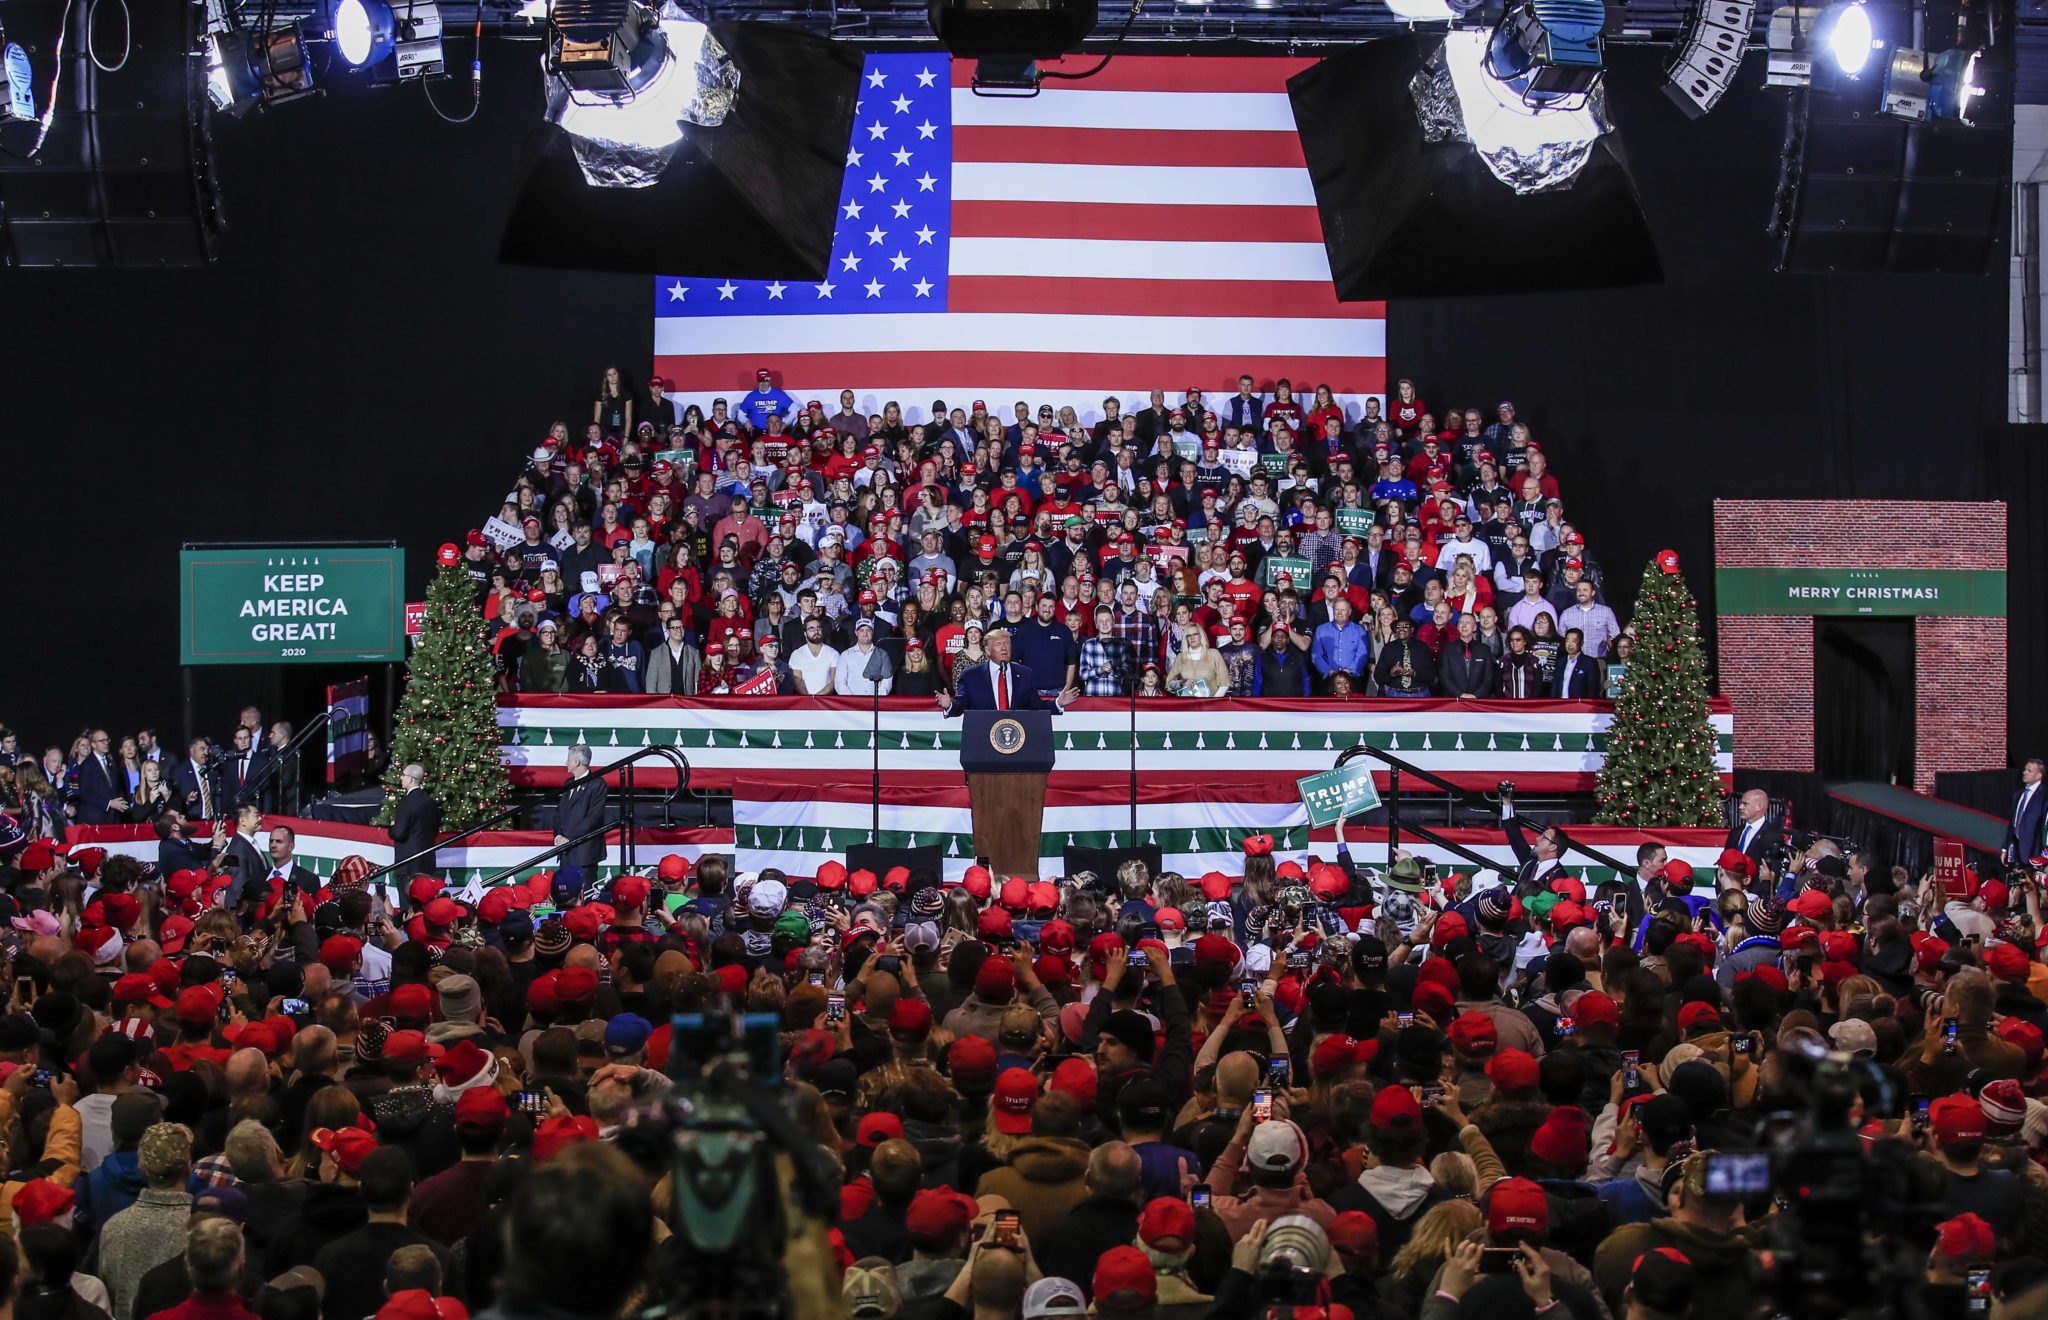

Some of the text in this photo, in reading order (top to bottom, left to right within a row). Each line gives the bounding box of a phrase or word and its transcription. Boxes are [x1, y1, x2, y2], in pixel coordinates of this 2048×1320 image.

[400, 53, 415, 61] ARRI
[1791, 63, 1805, 71] ARRI
[1336, 515, 1373, 524] TRUMP
[489, 525, 523, 541] TRUMP
[264, 574, 324, 592] KEEP
[1789, 587, 1938, 599] MERRY CHRISTMAS!
[239, 598, 348, 617] AMERICA
[251, 622, 336, 641] GREAT!
[281, 648, 306, 657] 2020
[1306, 776, 1367, 801] TRUMP
[1315, 789, 1365, 808] PENCE
